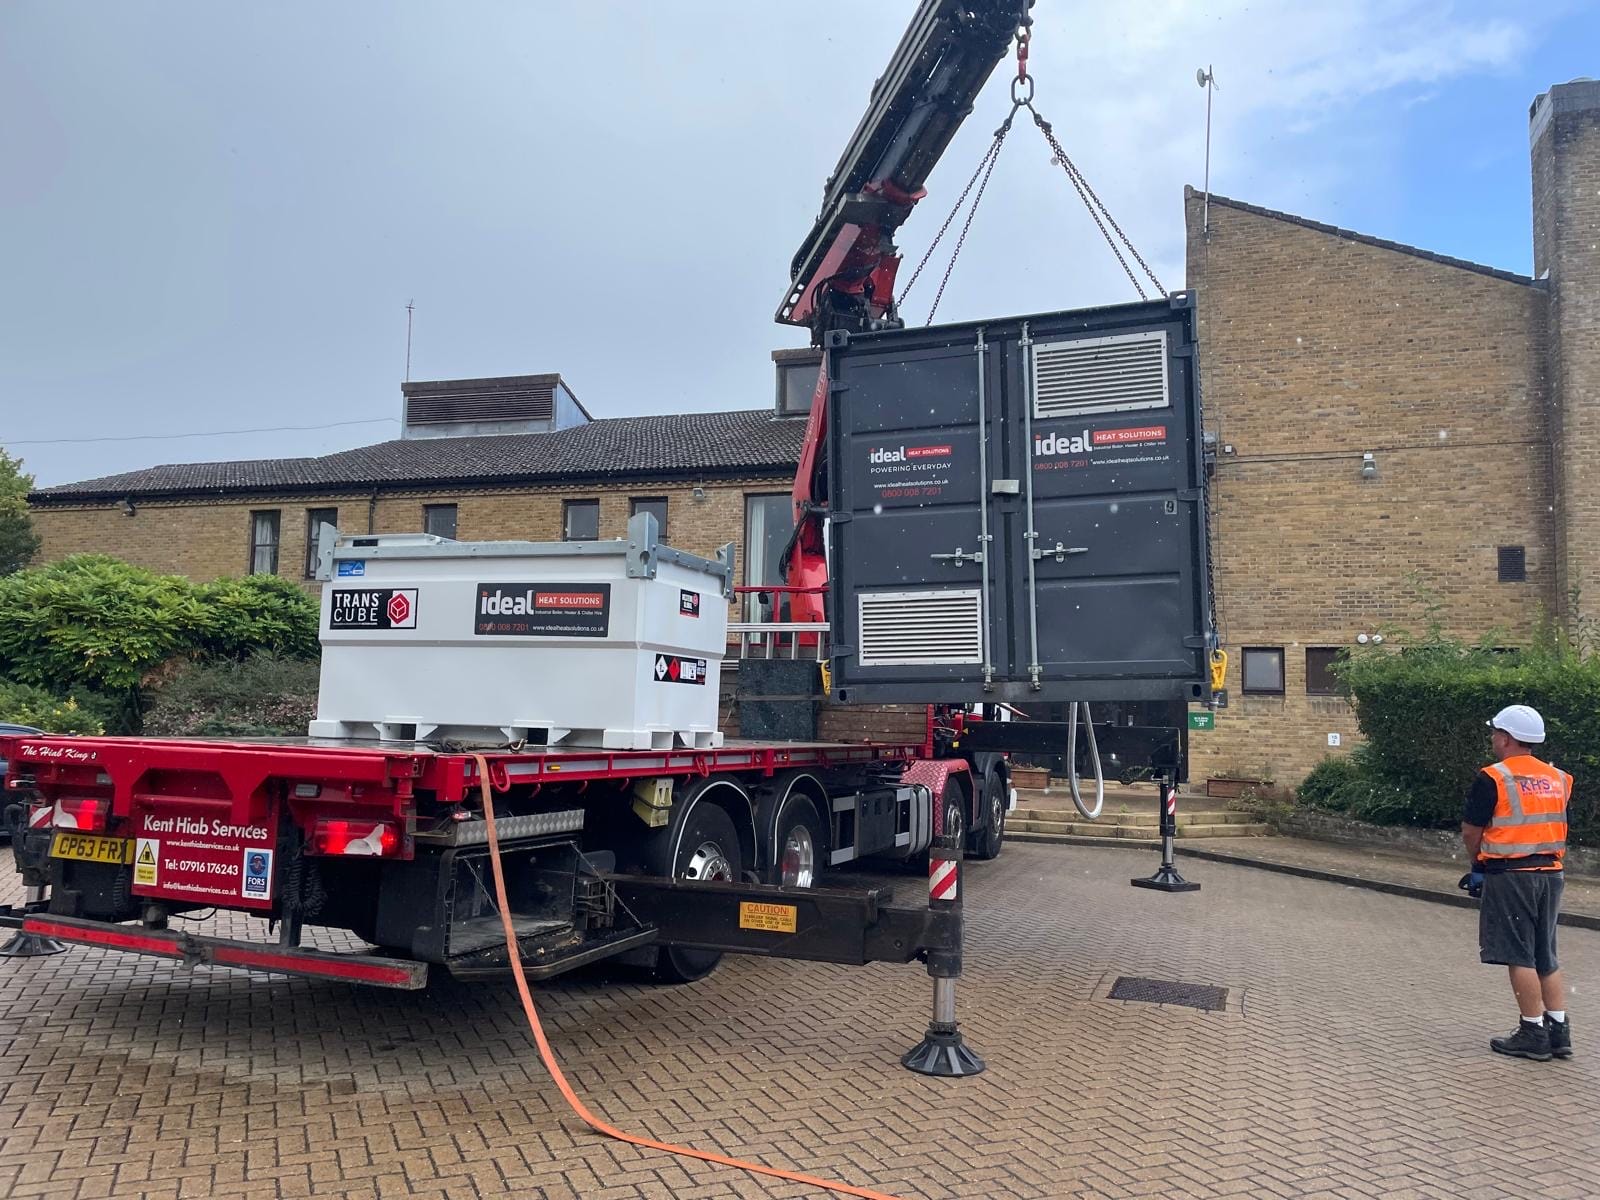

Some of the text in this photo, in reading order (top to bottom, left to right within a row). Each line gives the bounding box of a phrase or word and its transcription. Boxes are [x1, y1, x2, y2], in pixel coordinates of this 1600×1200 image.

[1035, 429, 1162, 456] ideal HEAT SOLUTIONS
[870, 446, 906, 464] ideal
[870, 462, 952, 474] POWERING EVERYDAY
[1035, 462, 1053, 470] 0800
[334, 592, 379, 608] TRANS
[481, 589, 600, 615] ideal HEAT SOLUTIONS
[333, 607, 378, 622] CUBE
[513, 623, 529, 632] 7201
[21, 745, 38, 756] The
[39, 746, 64, 757] Hiab
[64, 748, 88, 761] King
[1519, 778, 1551, 792] KHS
[143, 814, 268, 840] Kent Hiab Services
[59, 836, 95, 857] CP63
[166, 839, 240, 852] www.kenthiabservices.co.uk
[164, 859, 239, 876] Tel: 07916 176243
[163, 881, 237, 896] info@kenthiabservices.co.uk
[247, 876, 265, 886] FORS
[747, 903, 790, 915] CAUTION!
